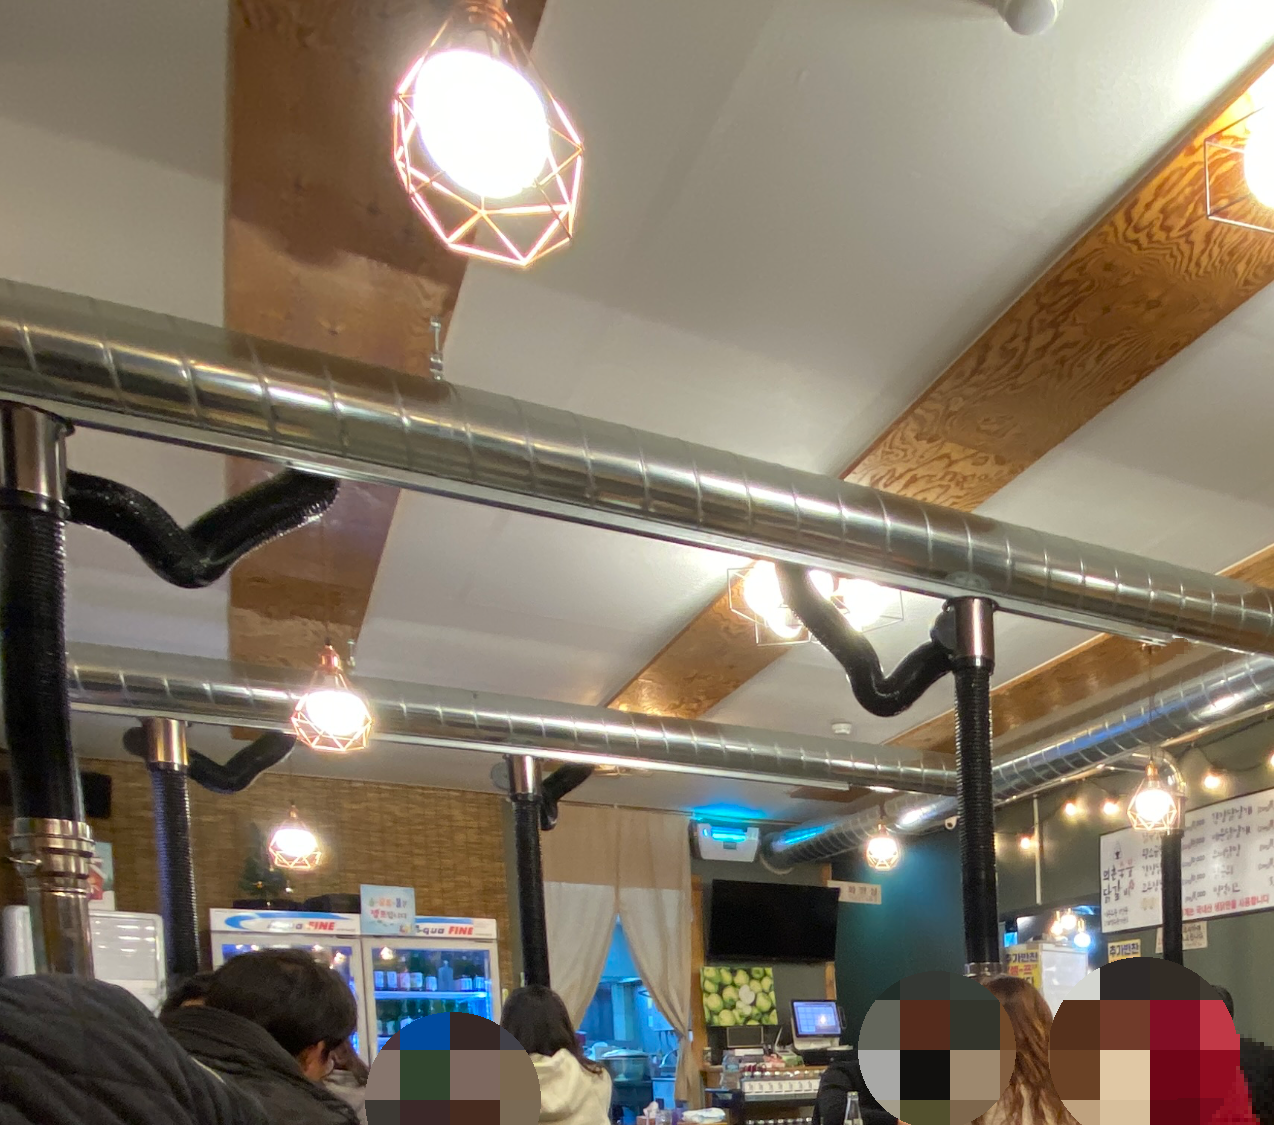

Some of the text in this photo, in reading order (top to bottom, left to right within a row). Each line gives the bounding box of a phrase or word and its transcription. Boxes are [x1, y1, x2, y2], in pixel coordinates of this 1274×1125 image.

[308, 921, 335, 931] FINE
[448, 926, 474, 936] FINE
[1109, 942, 1140, 958] 추가반찬
